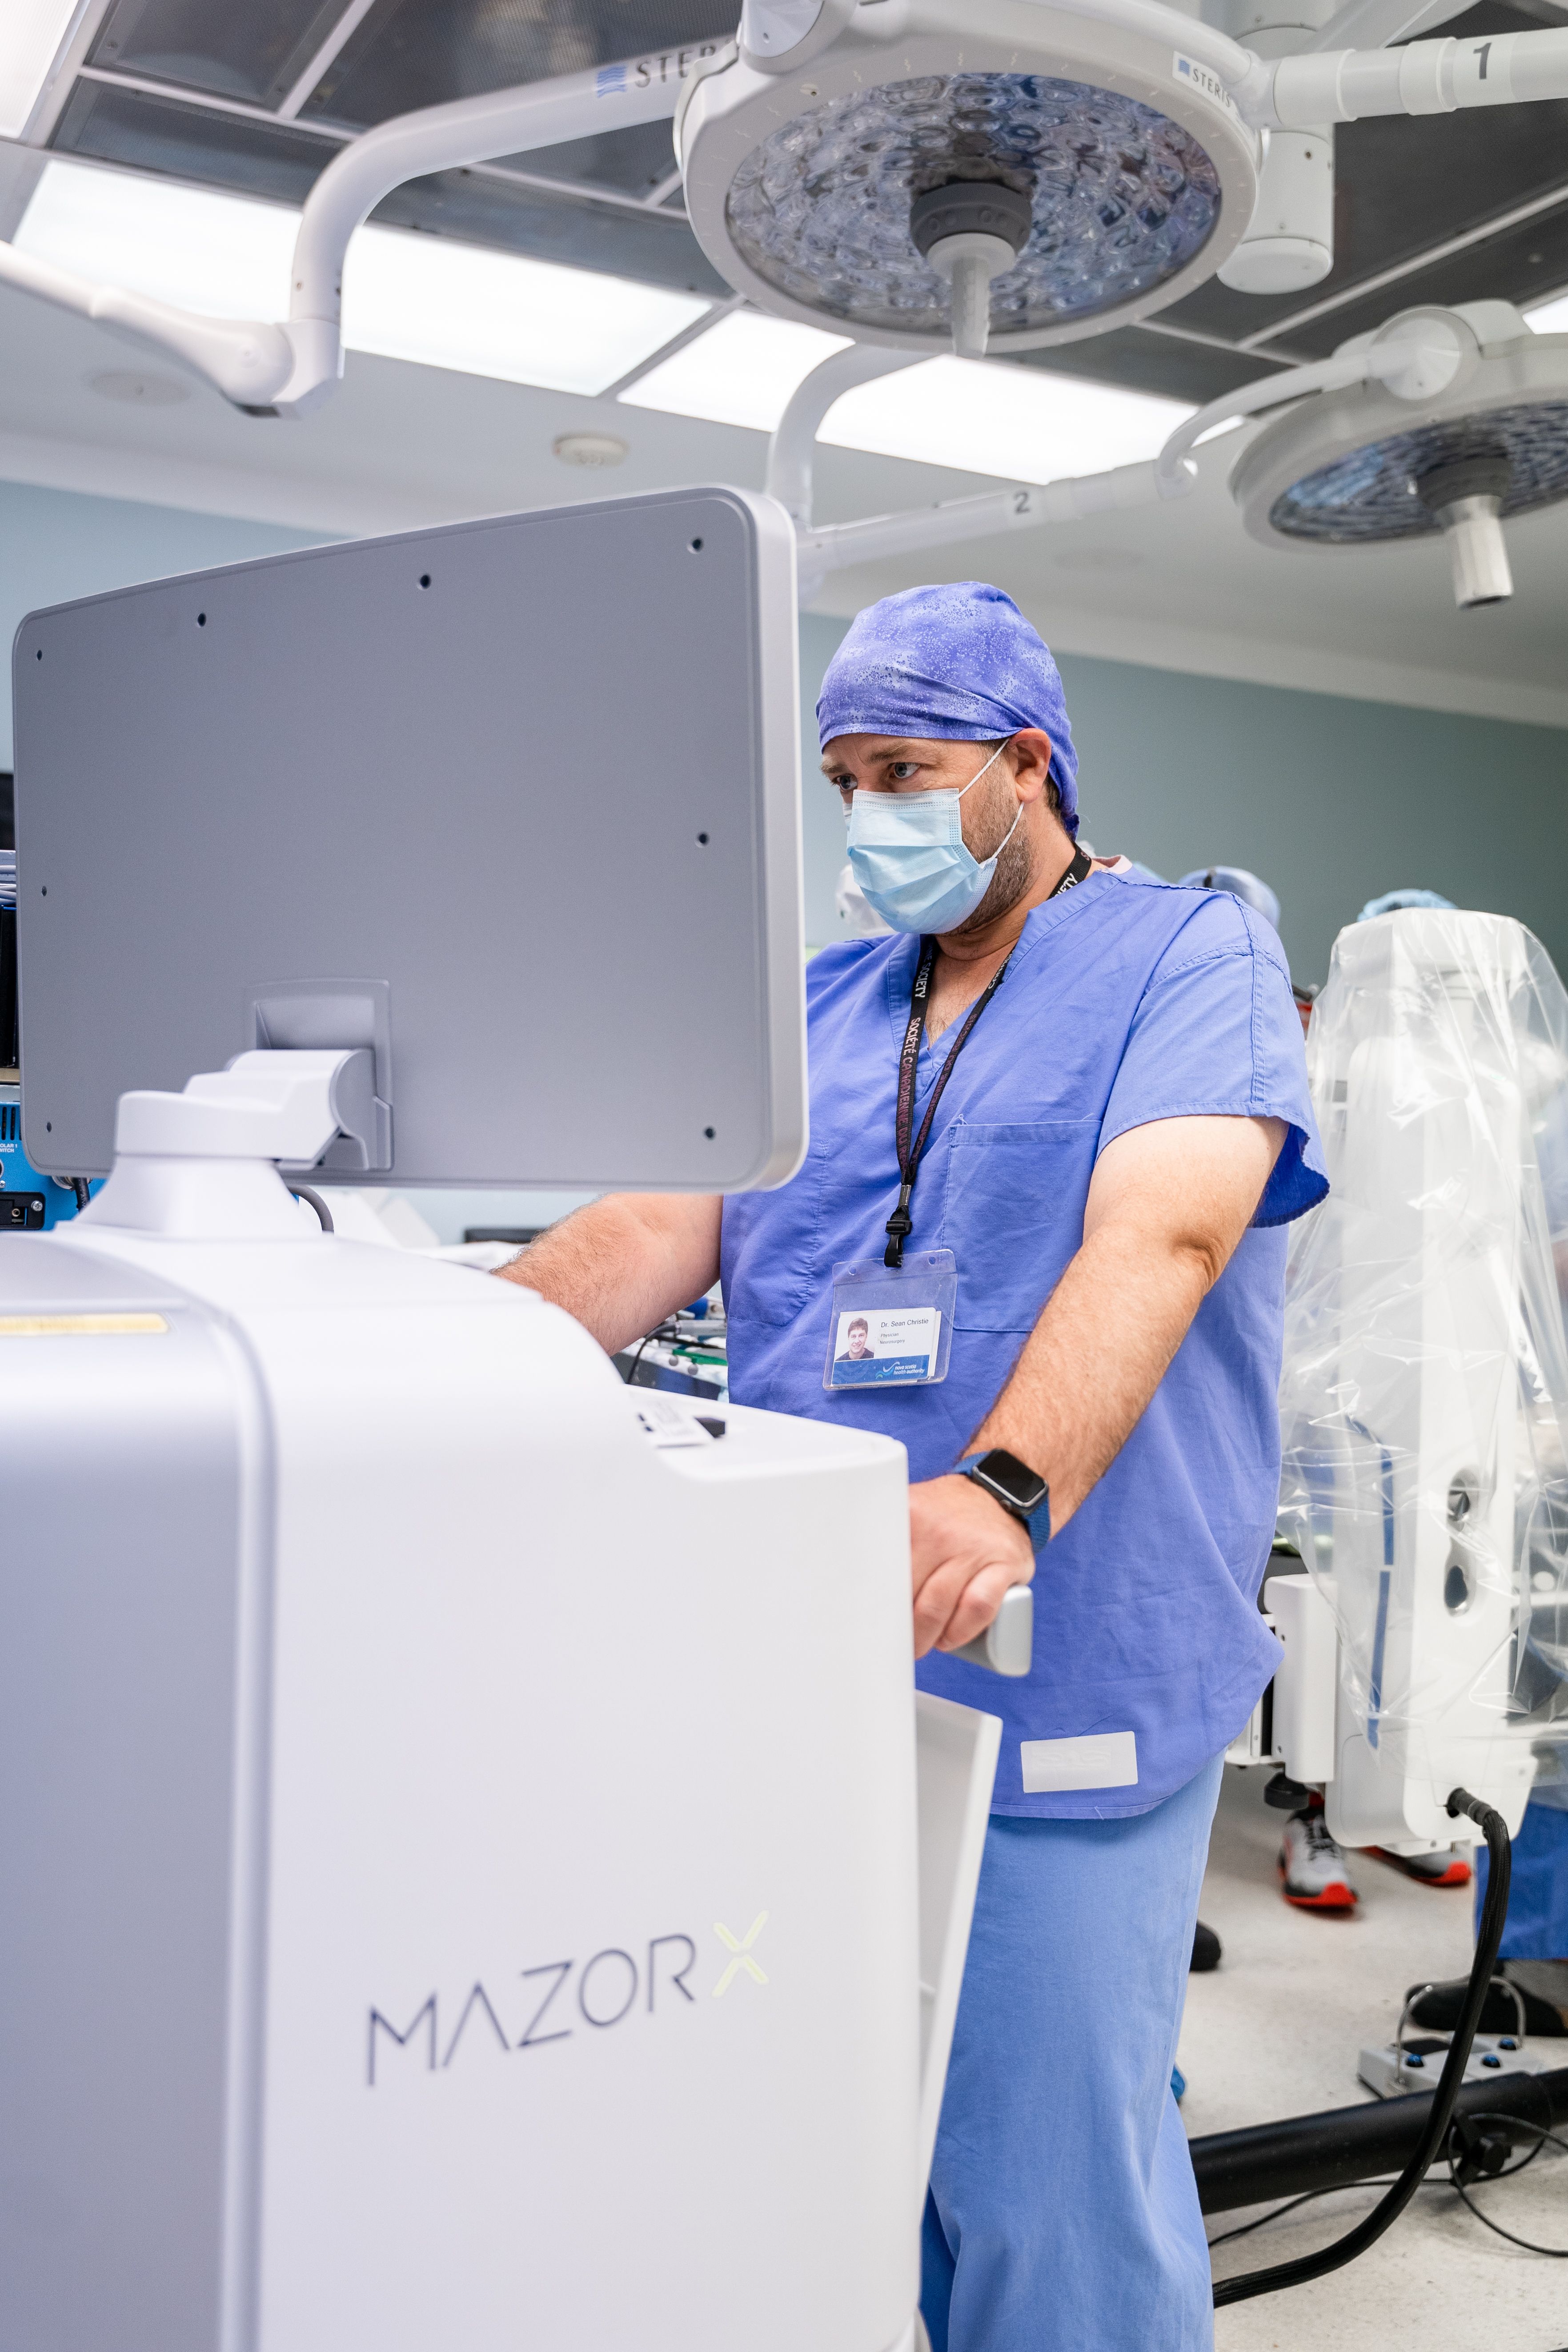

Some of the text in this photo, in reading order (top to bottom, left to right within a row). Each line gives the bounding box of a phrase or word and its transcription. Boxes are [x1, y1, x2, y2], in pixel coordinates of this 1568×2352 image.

[1472, 42, 1492, 80] 1
[1192, 68, 1231, 108] STERIS
[1013, 490, 1031, 514] 2
[1055, 873, 1078, 896] IETY
[915, 963, 931, 998] SOCIETY
[903, 1017, 921, 1056] SOCIÉTÉ
[898, 1057, 913, 1126] CANADIENNE
[898, 1127, 908, 1144] DU
